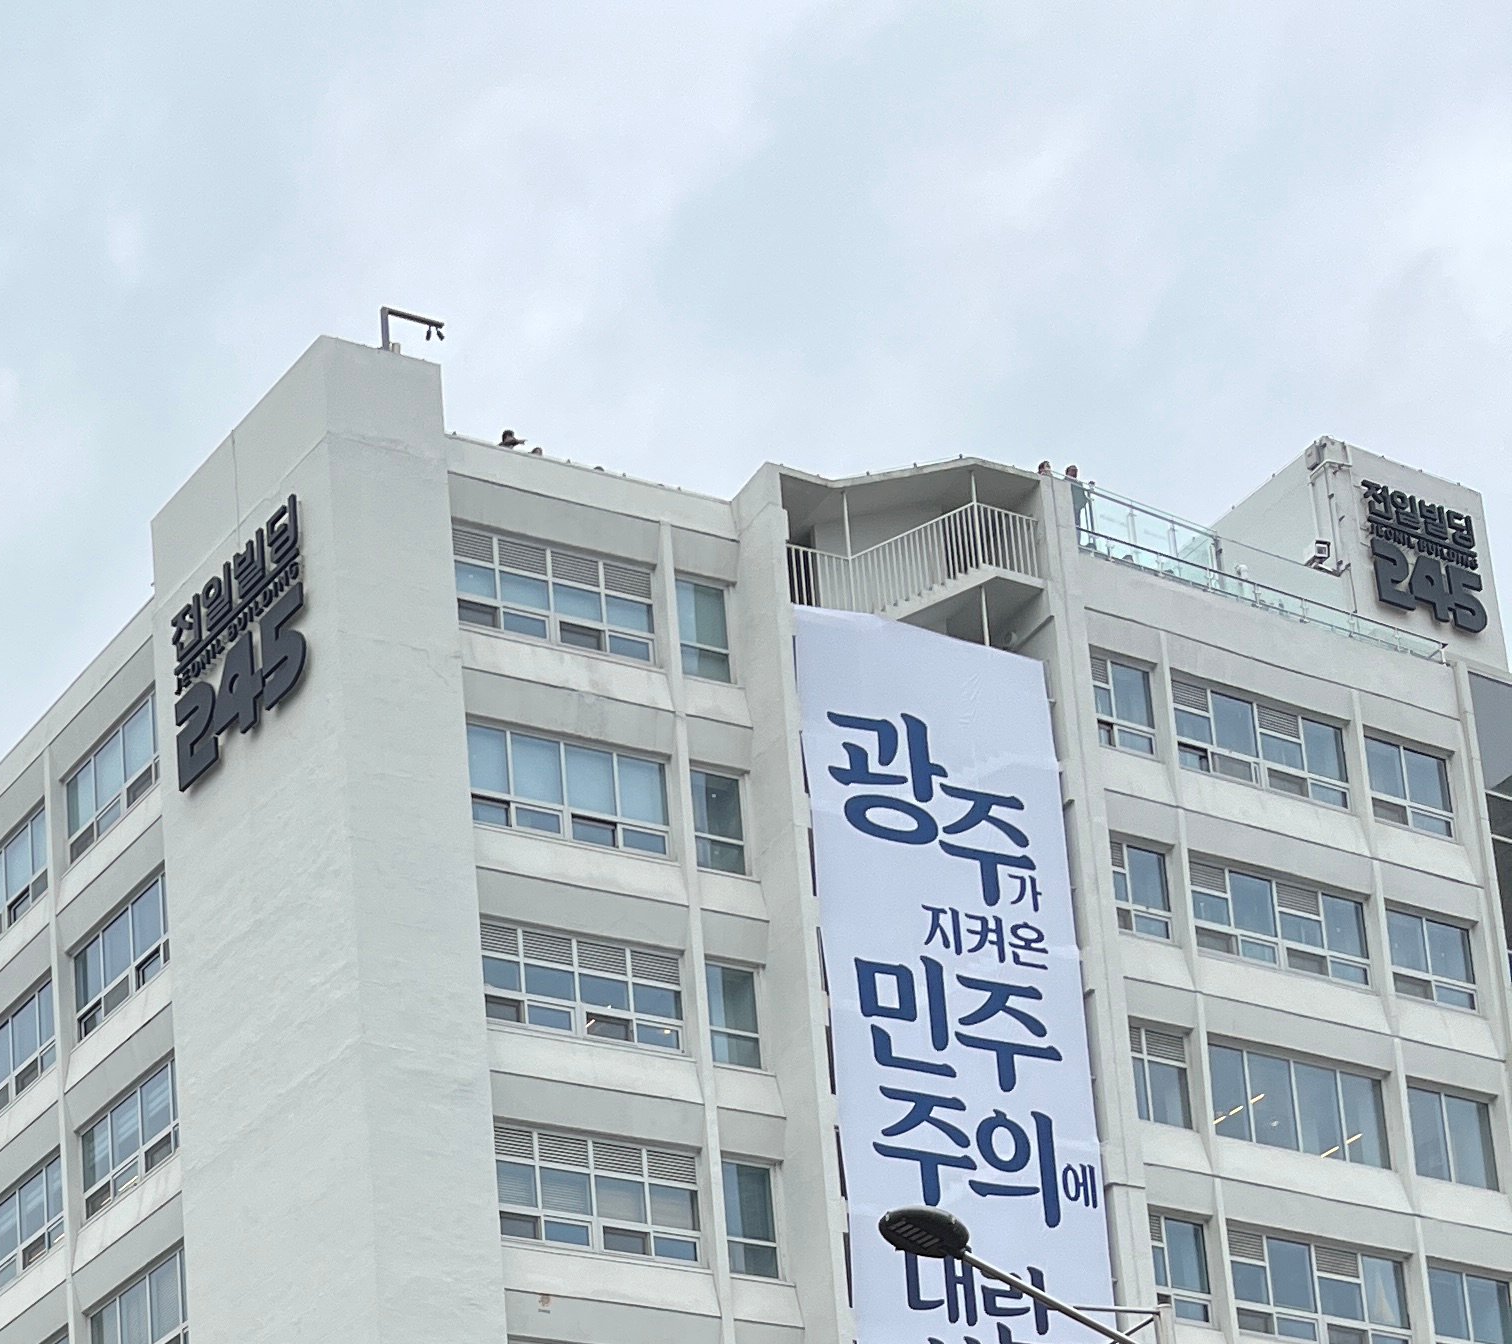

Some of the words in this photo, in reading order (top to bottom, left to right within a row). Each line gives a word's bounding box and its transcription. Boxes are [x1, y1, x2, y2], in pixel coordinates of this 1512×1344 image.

[171, 494, 300, 663] 전일빌딩
[1361, 480, 1475, 549] 전일빌딩
[1370, 537, 1488, 633] 245
[174, 582, 306, 792] 245
[826, 711, 1041, 913] 광주가
[922, 904, 1050, 970] 지켜온
